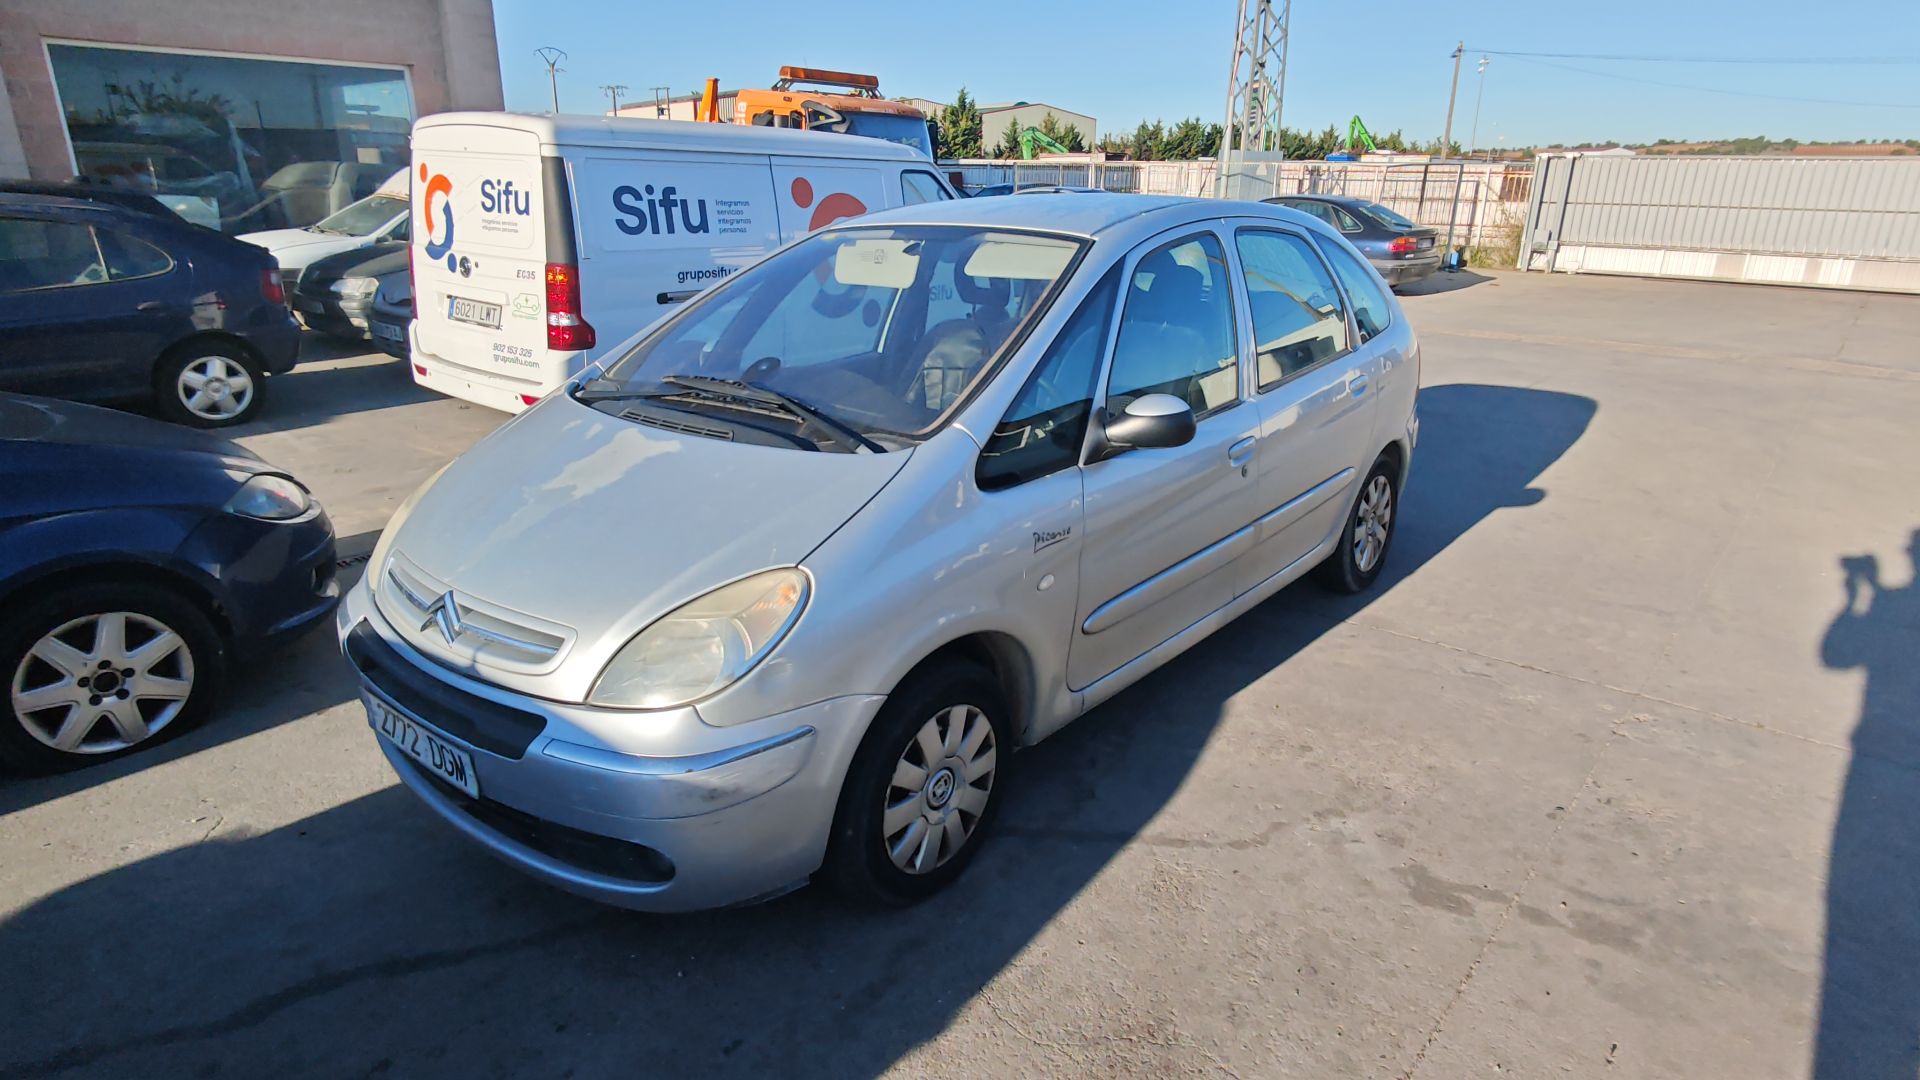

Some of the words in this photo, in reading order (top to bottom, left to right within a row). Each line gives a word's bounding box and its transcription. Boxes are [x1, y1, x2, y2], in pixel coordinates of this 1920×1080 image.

[481, 179, 530, 216] Sifu
[612, 184, 710, 235] Sifu
[516, 269, 536, 280] EC35
[455, 301, 476, 319] 6021
[480, 305, 498, 323] LWT
[493, 354, 540, 368] gruposifu.com
[376, 702, 422, 757] 2772
[426, 735, 468, 787] DGM
